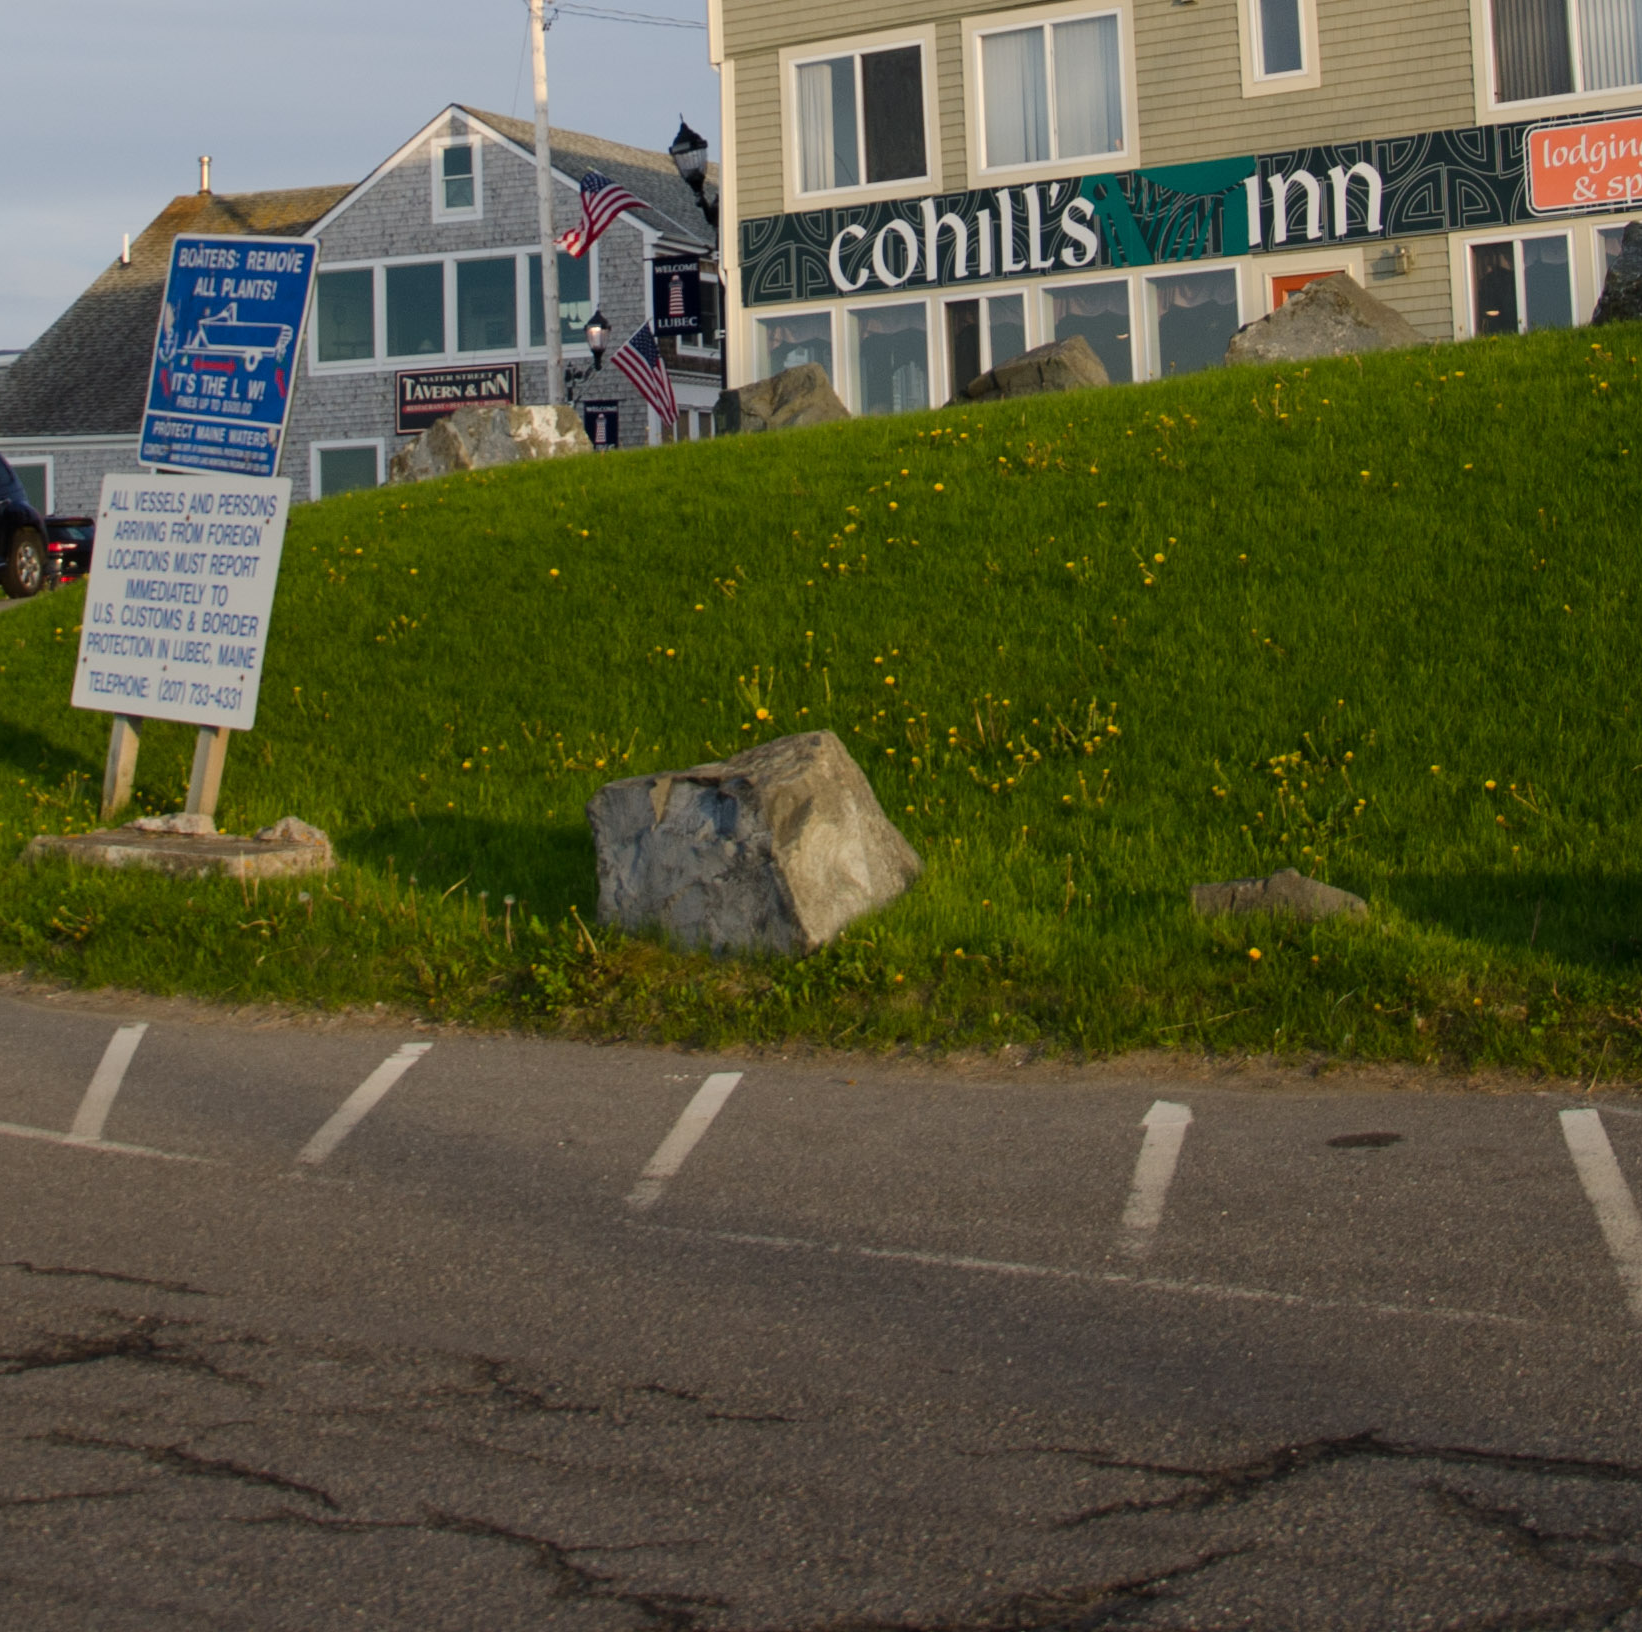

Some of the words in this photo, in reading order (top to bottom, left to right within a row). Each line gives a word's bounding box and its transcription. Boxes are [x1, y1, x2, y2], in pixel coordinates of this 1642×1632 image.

[1572, 176, 1598, 201] &
[829, 181, 1099, 292] cohill's
[1245, 161, 1383, 247] inn
[178, 247, 240, 269] BOATERS:
[246, 250, 305, 273] REMOVE
[655, 263, 698, 273] WELCOME
[193, 276, 217, 297] ALL
[220, 277, 278, 301] PLANTS!
[658, 317, 698, 329] LUBEC
[171, 372, 197, 394] IT'S
[201, 374, 228, 398] THE
[403, 377, 462, 400] TAVERN
[464, 384, 478, 397] &
[481, 370, 510, 396] INN
[419, 374, 454, 383] WATER
[455, 372, 494, 381] STREET
[152, 420, 194, 438] PROTECT
[195, 425, 227, 443] MAINE
[228, 429, 268, 448] WATERS
[109, 490, 129, 511] ALL
[134, 491, 186, 514] VESSELS
[189, 492, 215, 515] AND
[217, 493, 278, 518] PERSONS
[113, 520, 167, 542] ARRIVING
[169, 522, 205, 544] FROM
[207, 523, 263, 547] FOREIGN
[107, 548, 171, 572] LOCATIONS
[173, 552, 207, 574] MUST
[209, 554, 260, 578] REPORT
[125, 578, 206, 605] IMMEDIATELY
[211, 584, 229, 607] TO
[93, 602, 115, 625] U.S.
[121, 604, 183, 631] CUSTOMS
[187, 610, 196, 632] &
[202, 611, 259, 638] BORDER
[86, 632, 155, 659] PROTECTION
[157, 638, 171, 660] IN
[172, 640, 213, 667] LUBEC,
[217, 644, 257, 669] MAINE
[89, 670, 151, 698] TELEPHONE:
[158, 676, 187, 705] (207)
[189, 683, 243, 710] 733-4331
